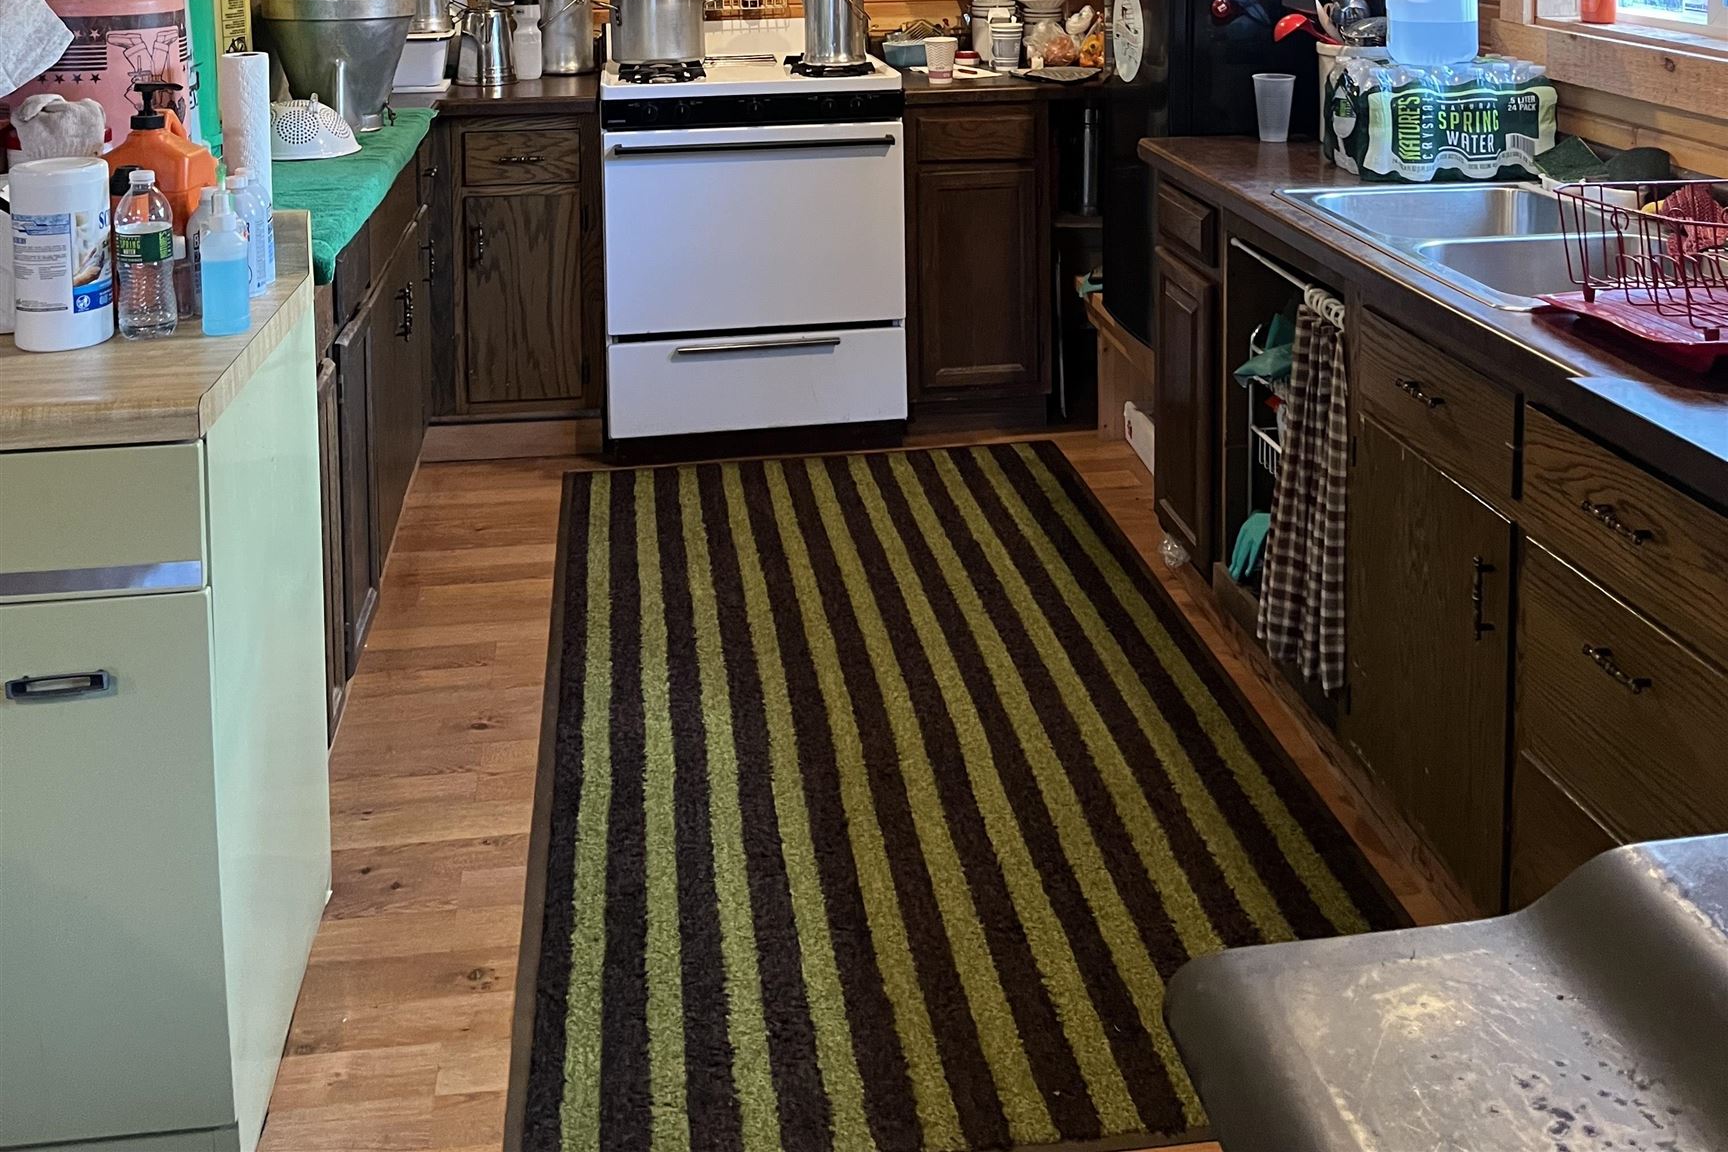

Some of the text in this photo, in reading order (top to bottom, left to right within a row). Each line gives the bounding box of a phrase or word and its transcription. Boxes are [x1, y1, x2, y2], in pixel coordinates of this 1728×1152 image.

[1440, 102, 1497, 111] NATURAL
[1507, 103, 1537, 112] 24 PACK
[1398, 96, 1421, 160] NATURE'S
[1422, 95, 1433, 160] CRYSTAL
[1438, 109, 1499, 133] SPRING
[1446, 130, 1495, 153] WATER
